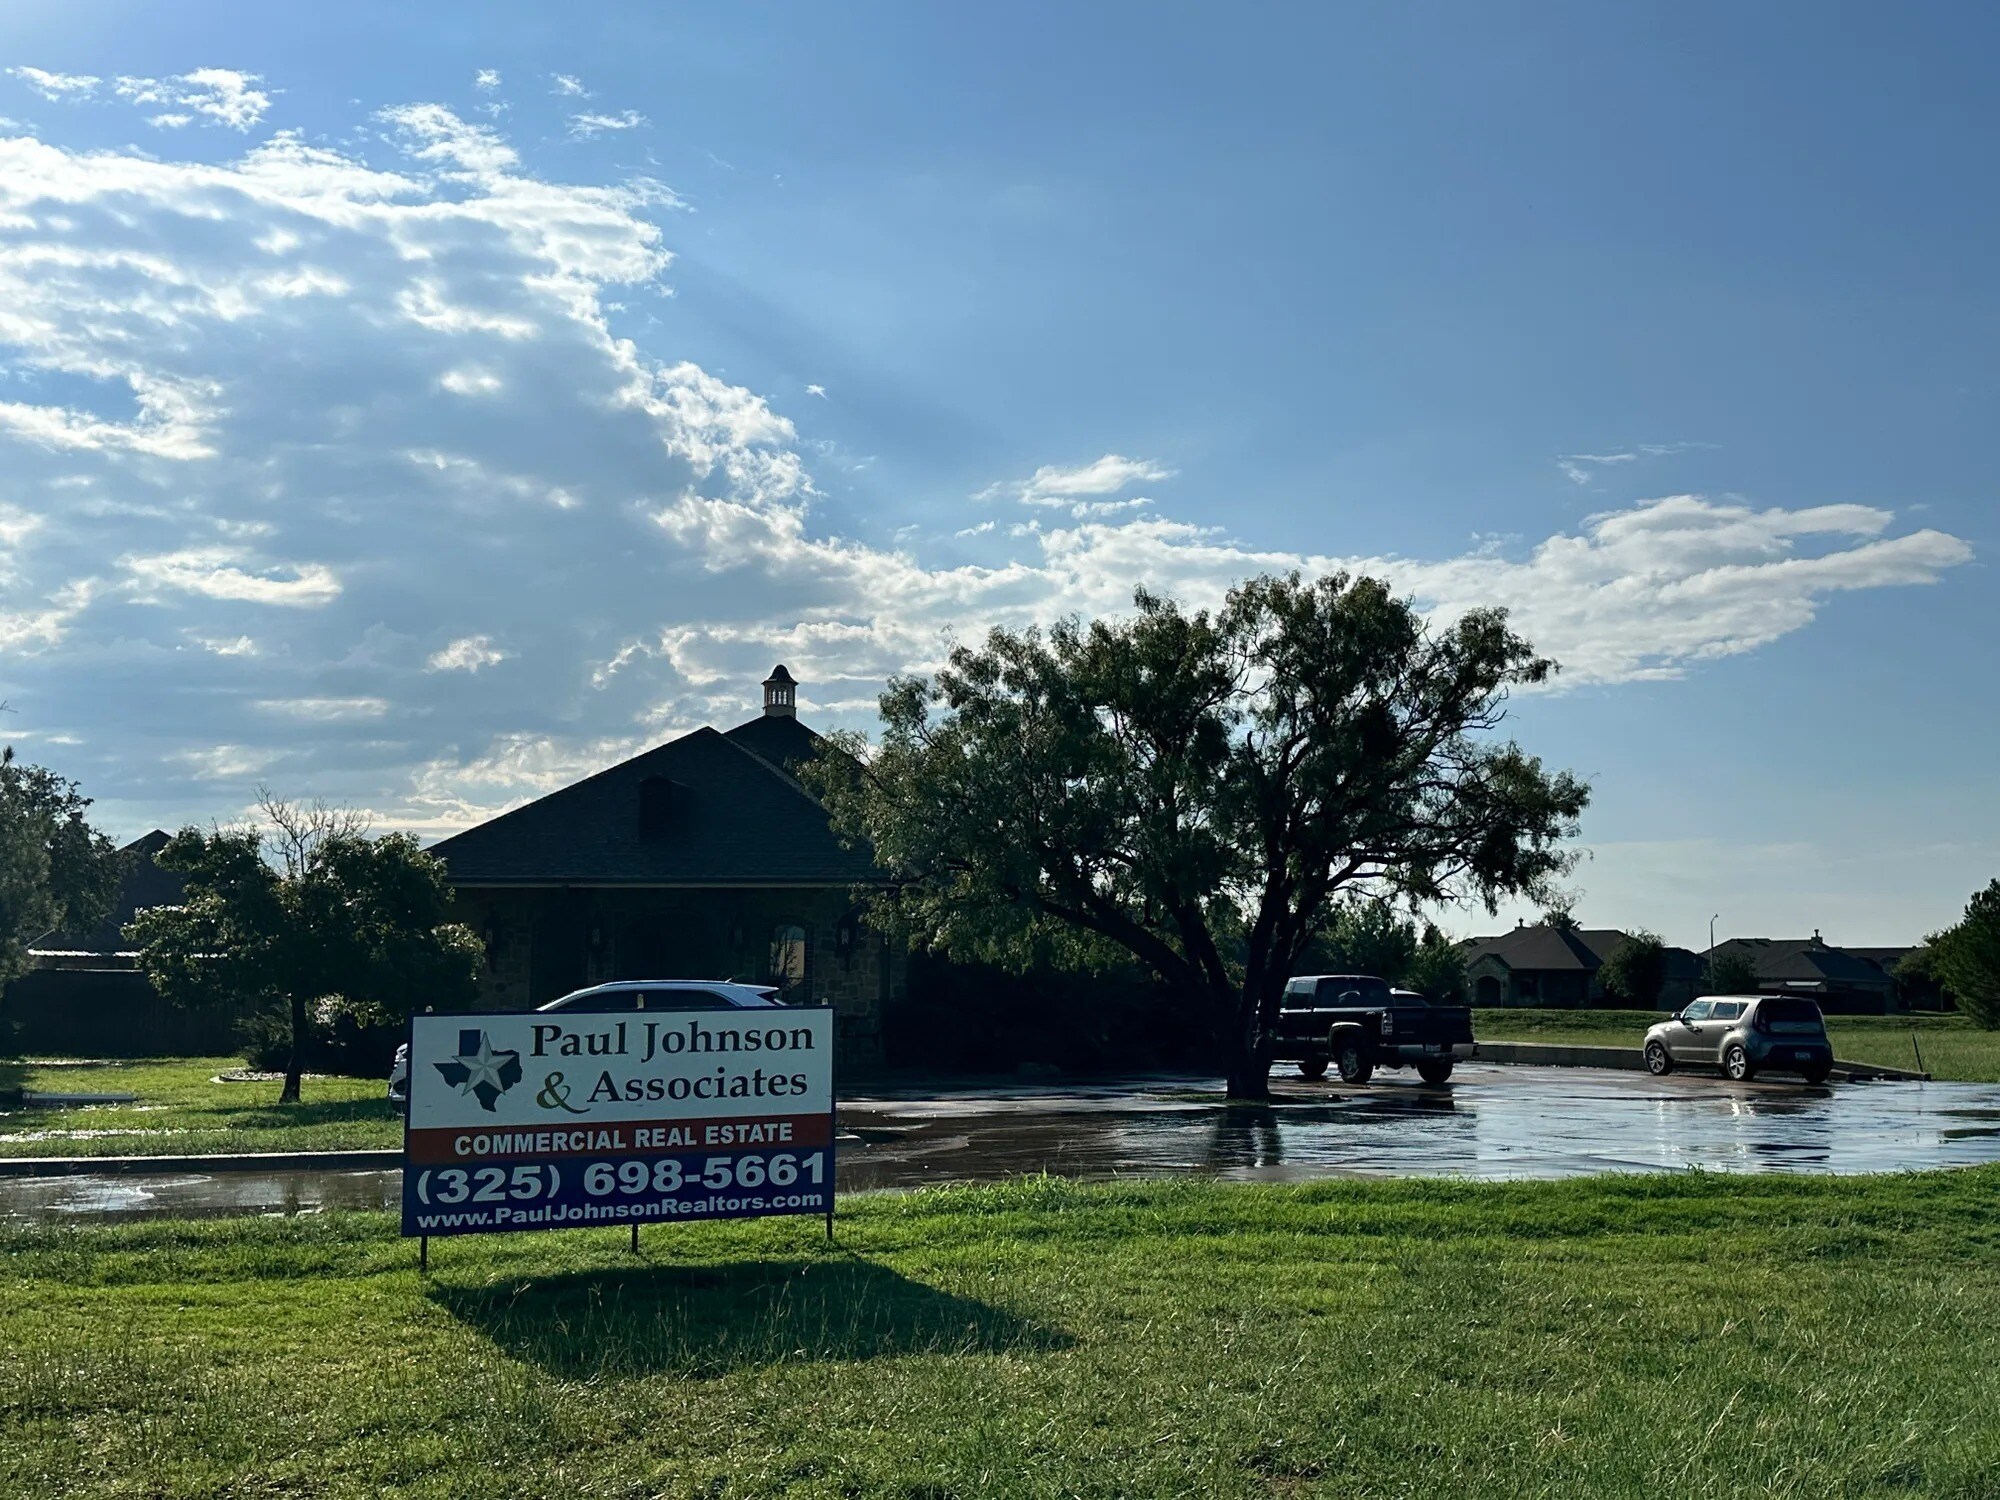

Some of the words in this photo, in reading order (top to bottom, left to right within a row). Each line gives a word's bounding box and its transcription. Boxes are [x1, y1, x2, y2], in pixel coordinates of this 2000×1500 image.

[530, 1022, 627, 1057] Paul
[641, 1020, 815, 1063] Johnson
[536, 1071, 590, 1114] &
[588, 1067, 808, 1103] Associates
[455, 1129, 626, 1156] COMMERCIAL
[635, 1126, 697, 1149] REAL
[705, 1122, 793, 1145] ESTATE
[417, 1164, 560, 1205] (325)
[583, 1151, 824, 1196] 698-5661
[417, 1192, 823, 1229] www.PaulJohnsonRealtors.com
